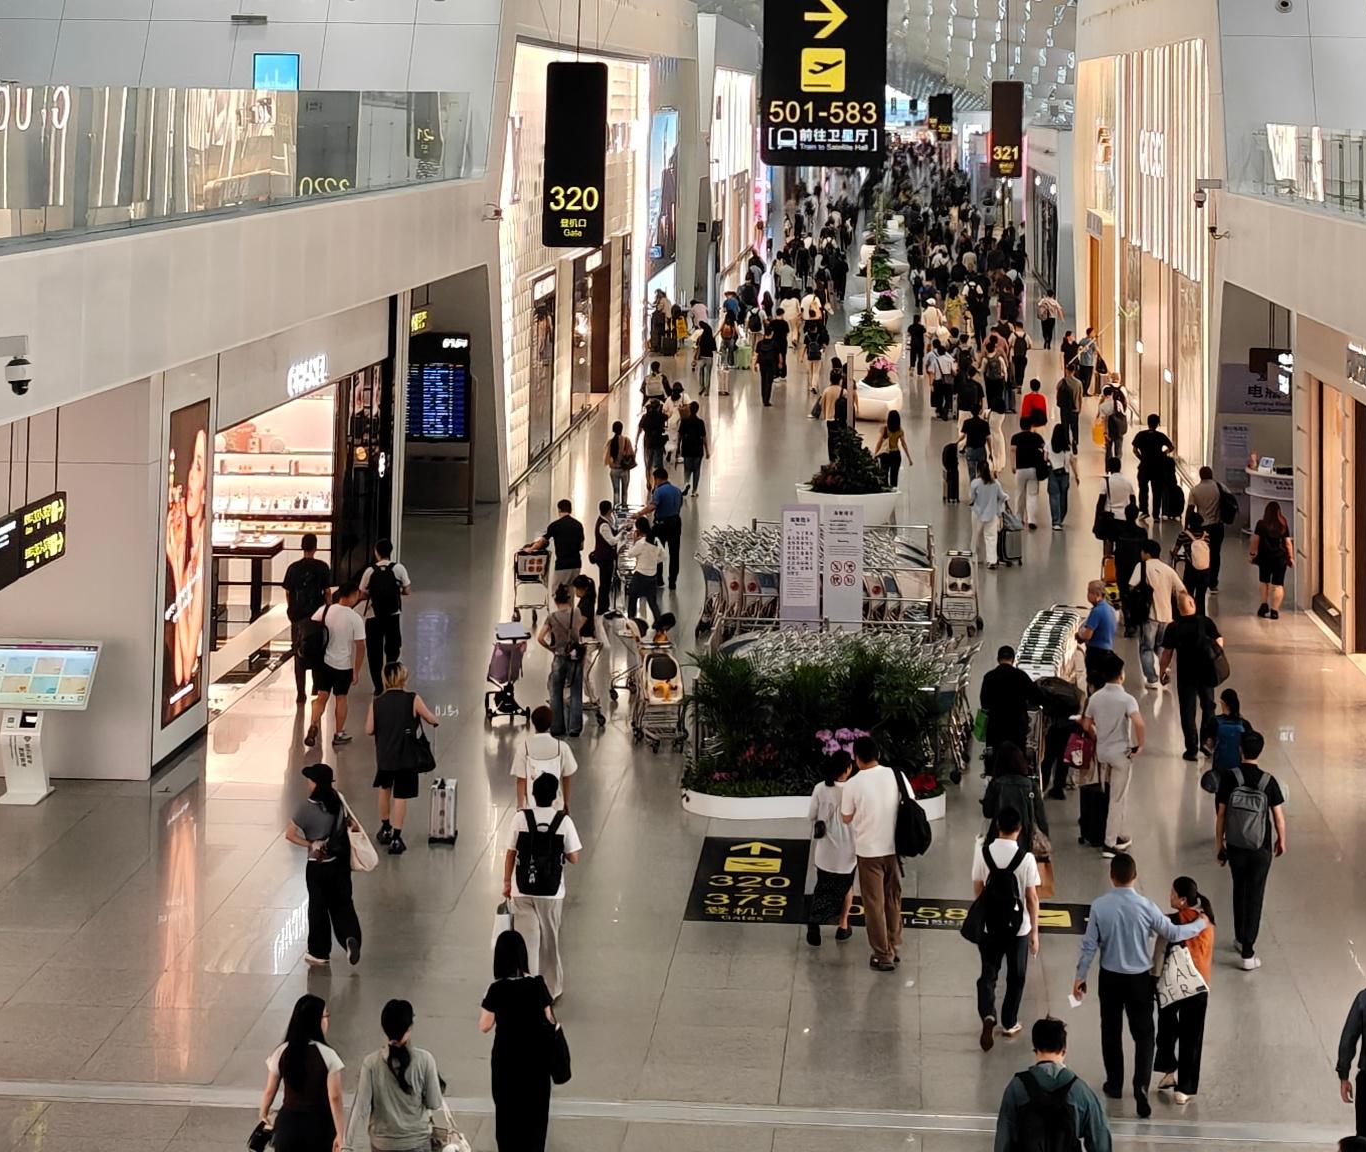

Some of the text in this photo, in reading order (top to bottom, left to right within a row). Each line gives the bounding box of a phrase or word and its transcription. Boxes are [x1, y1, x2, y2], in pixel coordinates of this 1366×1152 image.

[769, 100, 877, 124] 501-583
[799, 128, 869, 142] 前往卫星厅
[993, 146, 1019, 160] 321
[549, 186, 599, 211] 320
[708, 874, 791, 888] 320
[703, 893, 788, 907] 378
[705, 906, 784, 916] 登机口
